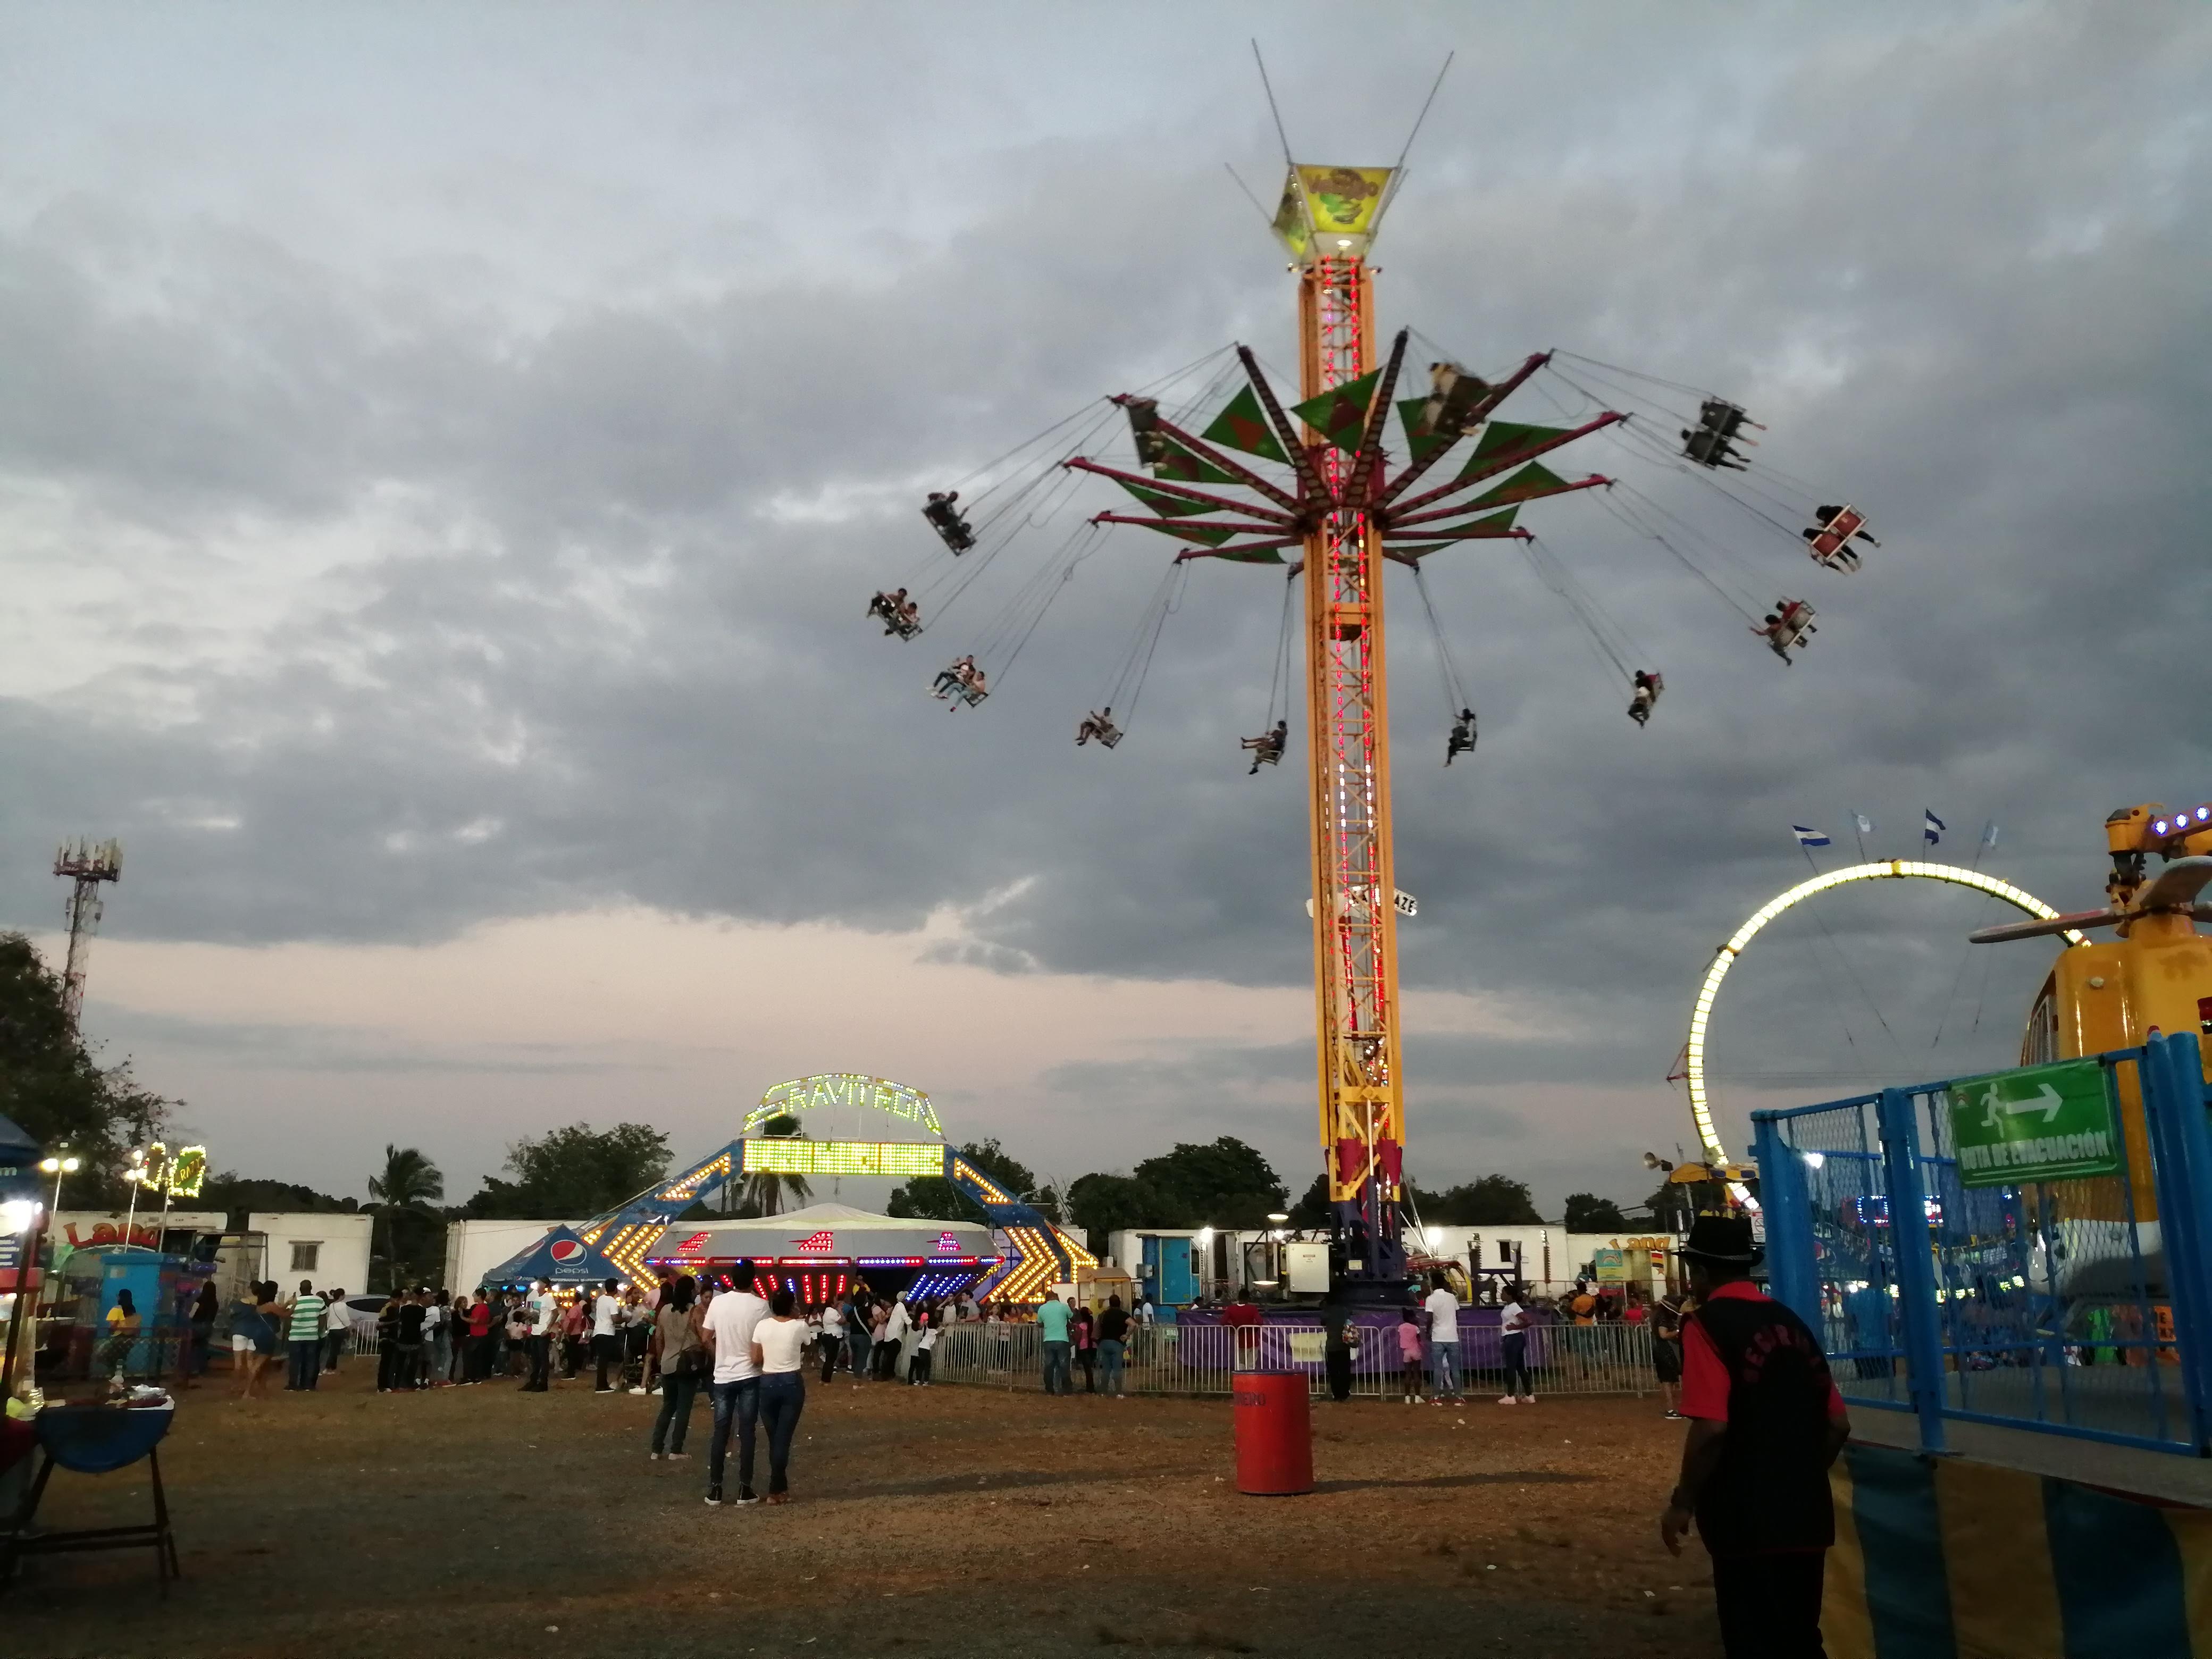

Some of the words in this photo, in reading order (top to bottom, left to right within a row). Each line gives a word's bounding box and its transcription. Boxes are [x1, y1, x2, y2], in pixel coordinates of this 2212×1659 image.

[741, 1077, 946, 1141] GRAVITRON
[1960, 1145, 1991, 1170] RUTA
[1991, 1142, 2009, 1166] DE
[2010, 1128, 2110, 1165] EVACUACIÓN
